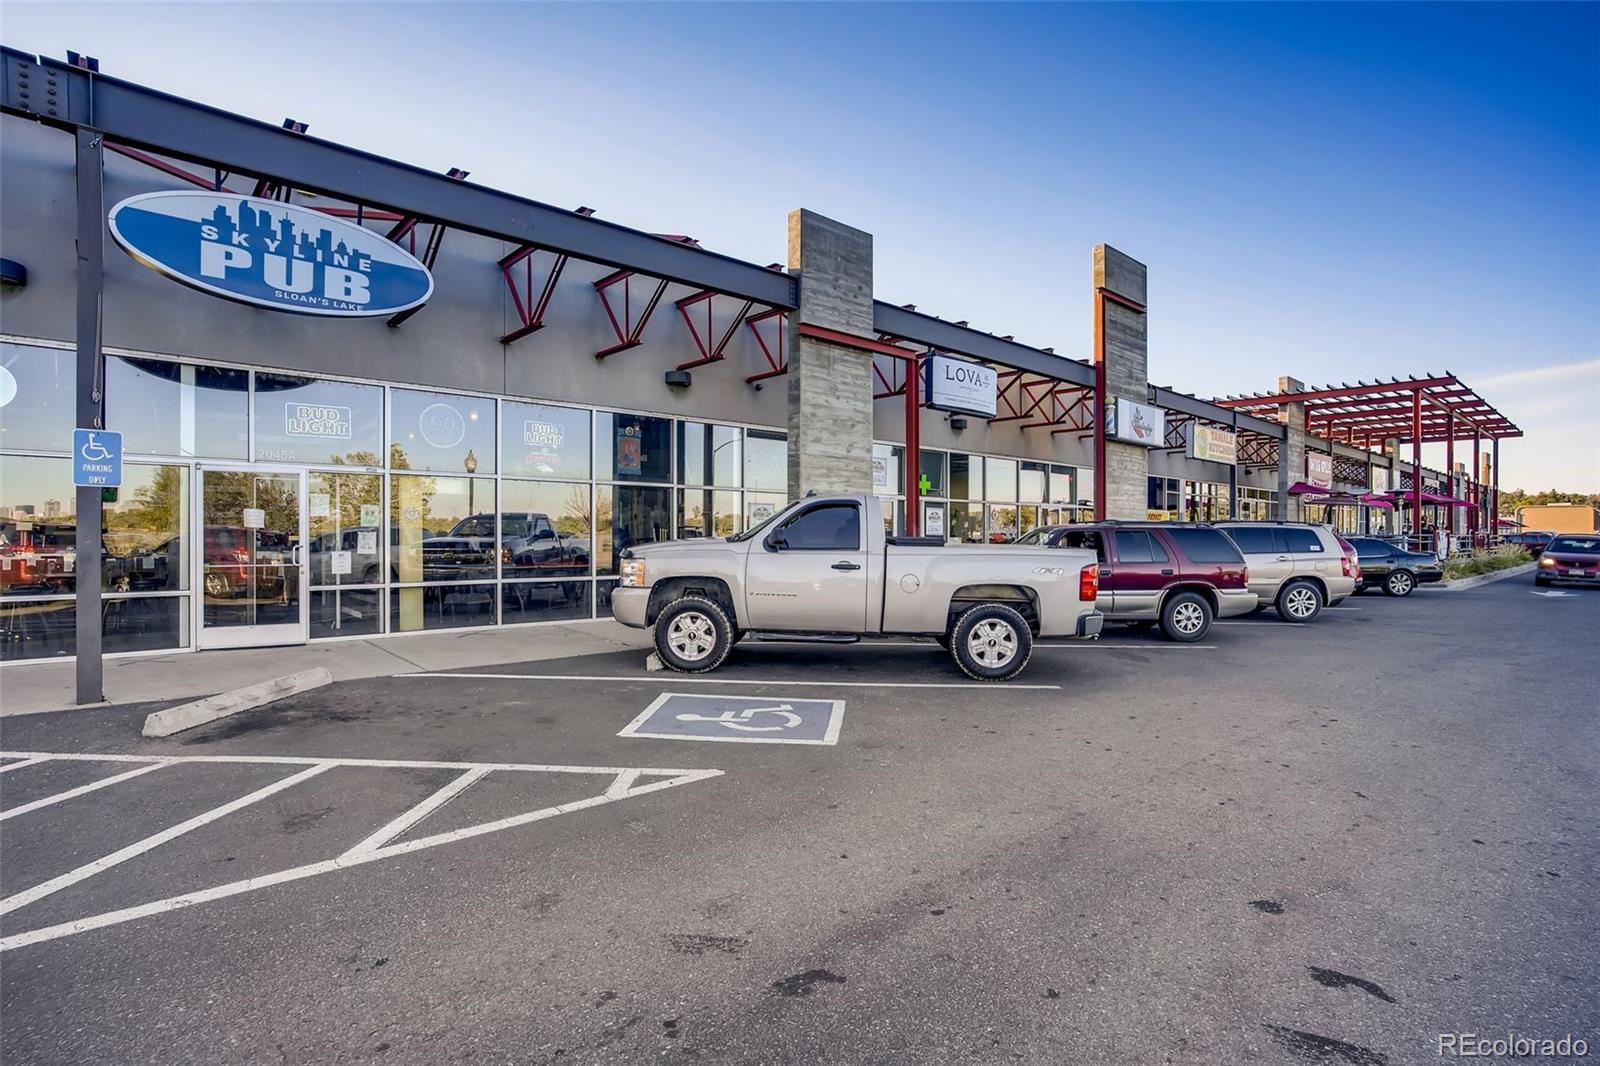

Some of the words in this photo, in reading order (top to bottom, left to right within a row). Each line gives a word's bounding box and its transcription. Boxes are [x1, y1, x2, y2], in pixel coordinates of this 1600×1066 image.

[201, 225, 372, 272] SKYLINE
[200, 239, 371, 304] PUB
[275, 290, 329, 306] SLOAN'S
[333, 301, 363, 312] LAKE
[945, 365, 982, 387] LOVA
[297, 406, 340, 422] BUD
[289, 419, 348, 436] LIGHT
[531, 423, 559, 435] BUD
[527, 432, 562, 446] LIGHT
[82, 463, 113, 473] PARKING
[89, 476, 107, 484] ONLY
